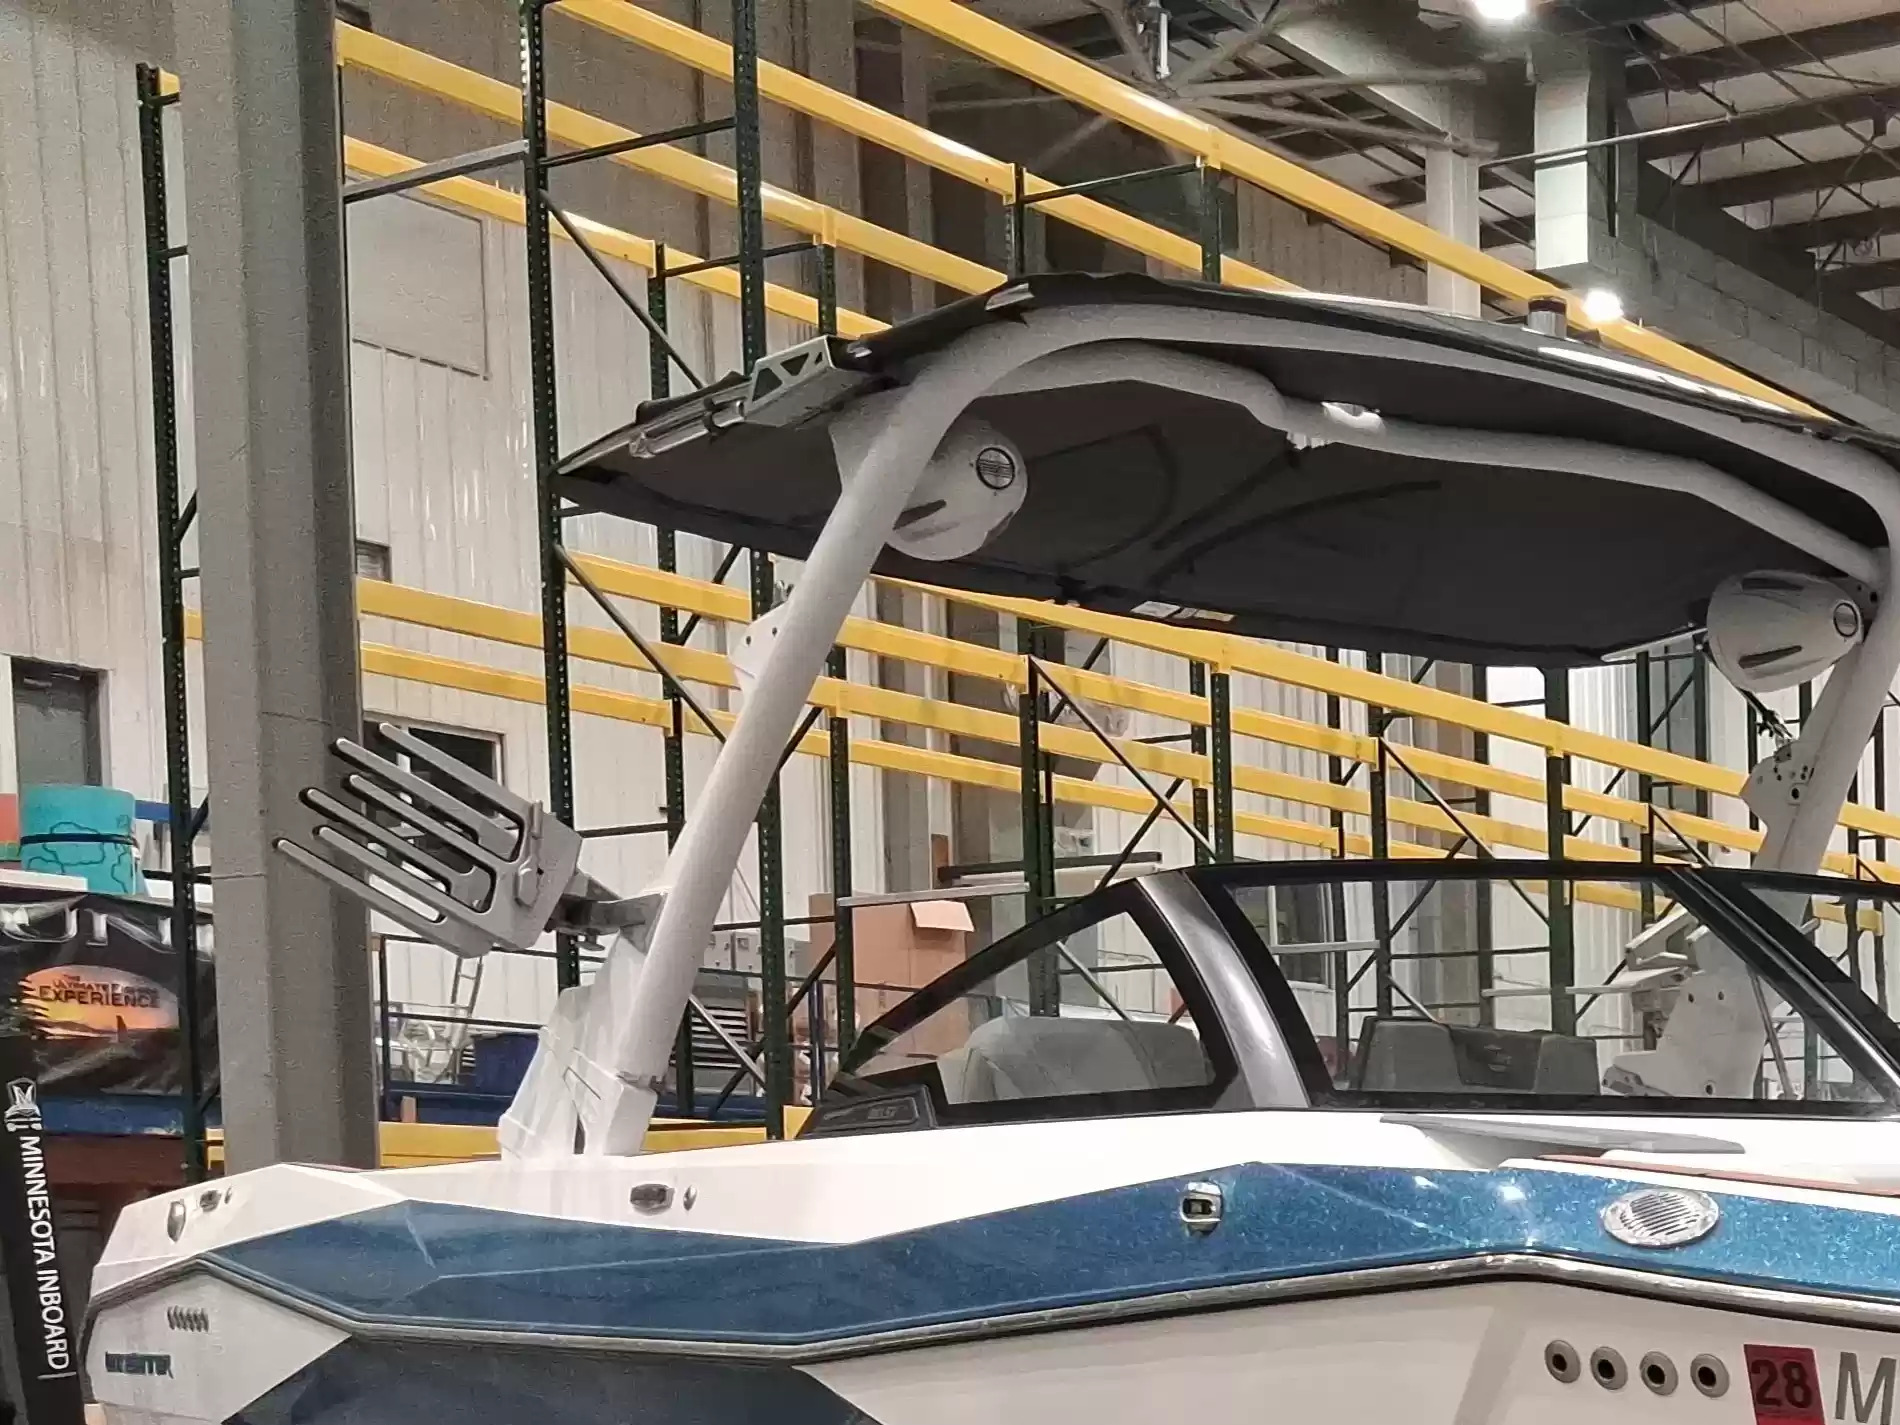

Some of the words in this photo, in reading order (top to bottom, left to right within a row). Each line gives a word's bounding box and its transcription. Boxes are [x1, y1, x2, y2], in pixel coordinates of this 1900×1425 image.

[39, 985, 161, 1009] EXPERIENCE
[20, 1135, 56, 1269] MINNESOTA
[37, 1270, 70, 1370] INBOARD
[1751, 1359, 1813, 1408] 28
